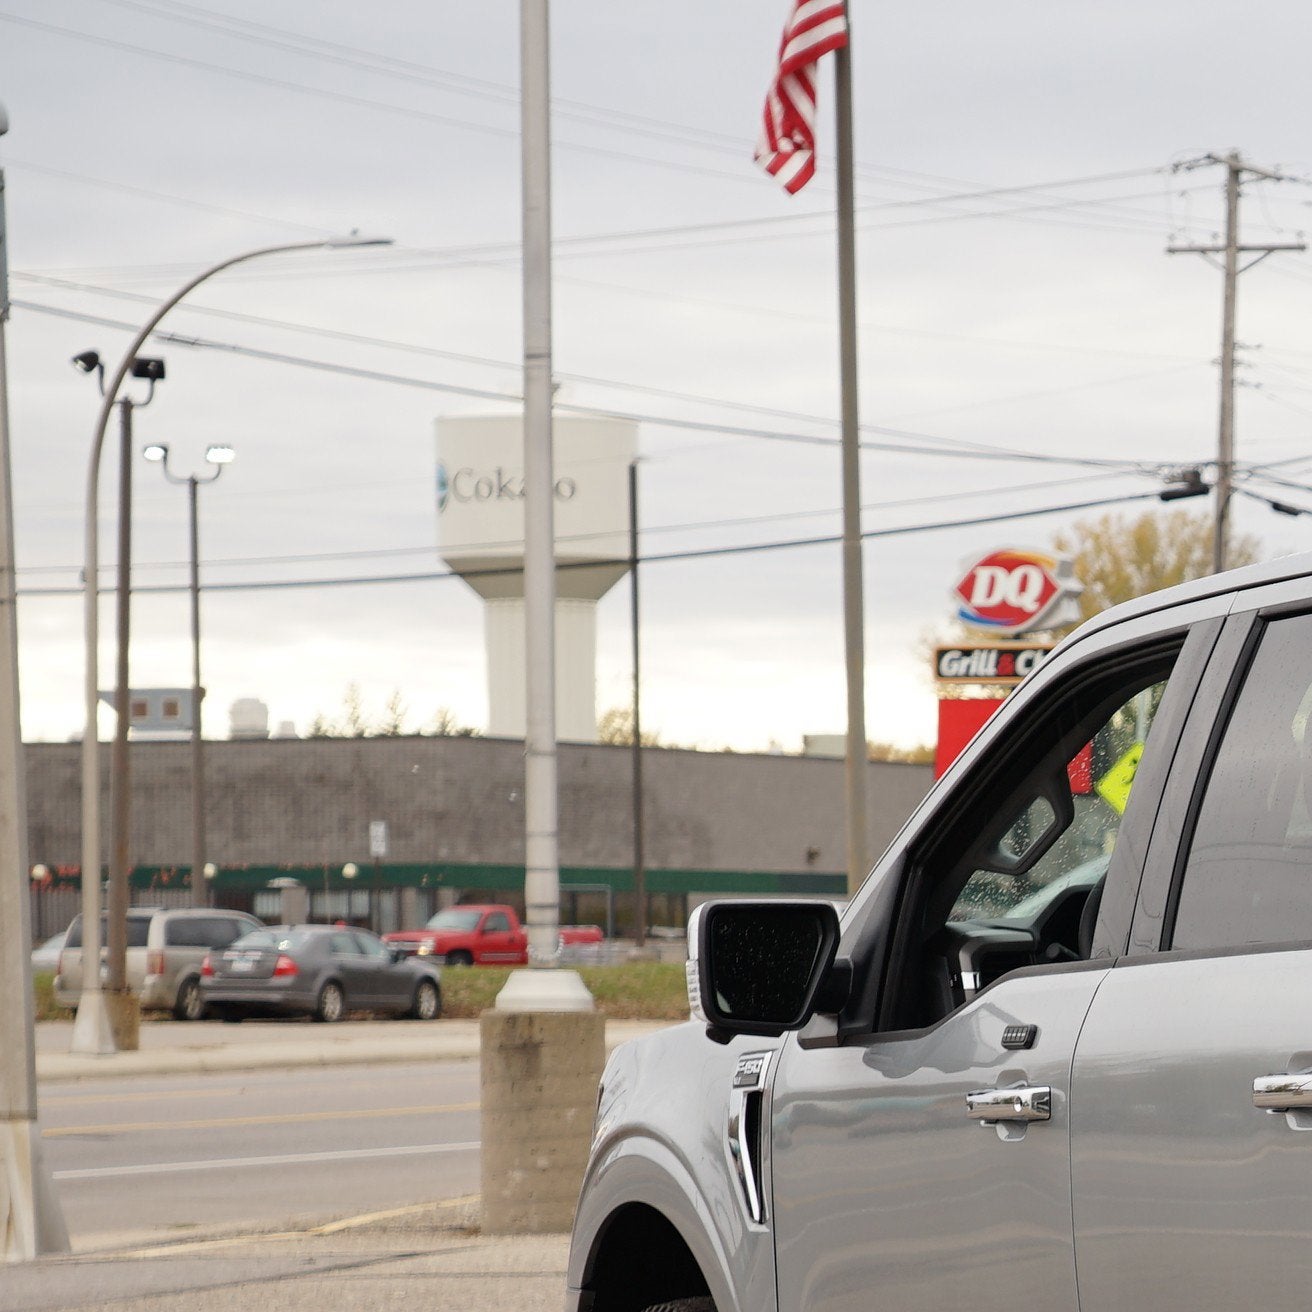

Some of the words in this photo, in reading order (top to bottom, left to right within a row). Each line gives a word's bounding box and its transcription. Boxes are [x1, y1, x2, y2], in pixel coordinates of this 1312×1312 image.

[452, 466, 576, 503] Coko
[970, 564, 1045, 613] DQ
[940, 649, 998, 677] Grill
